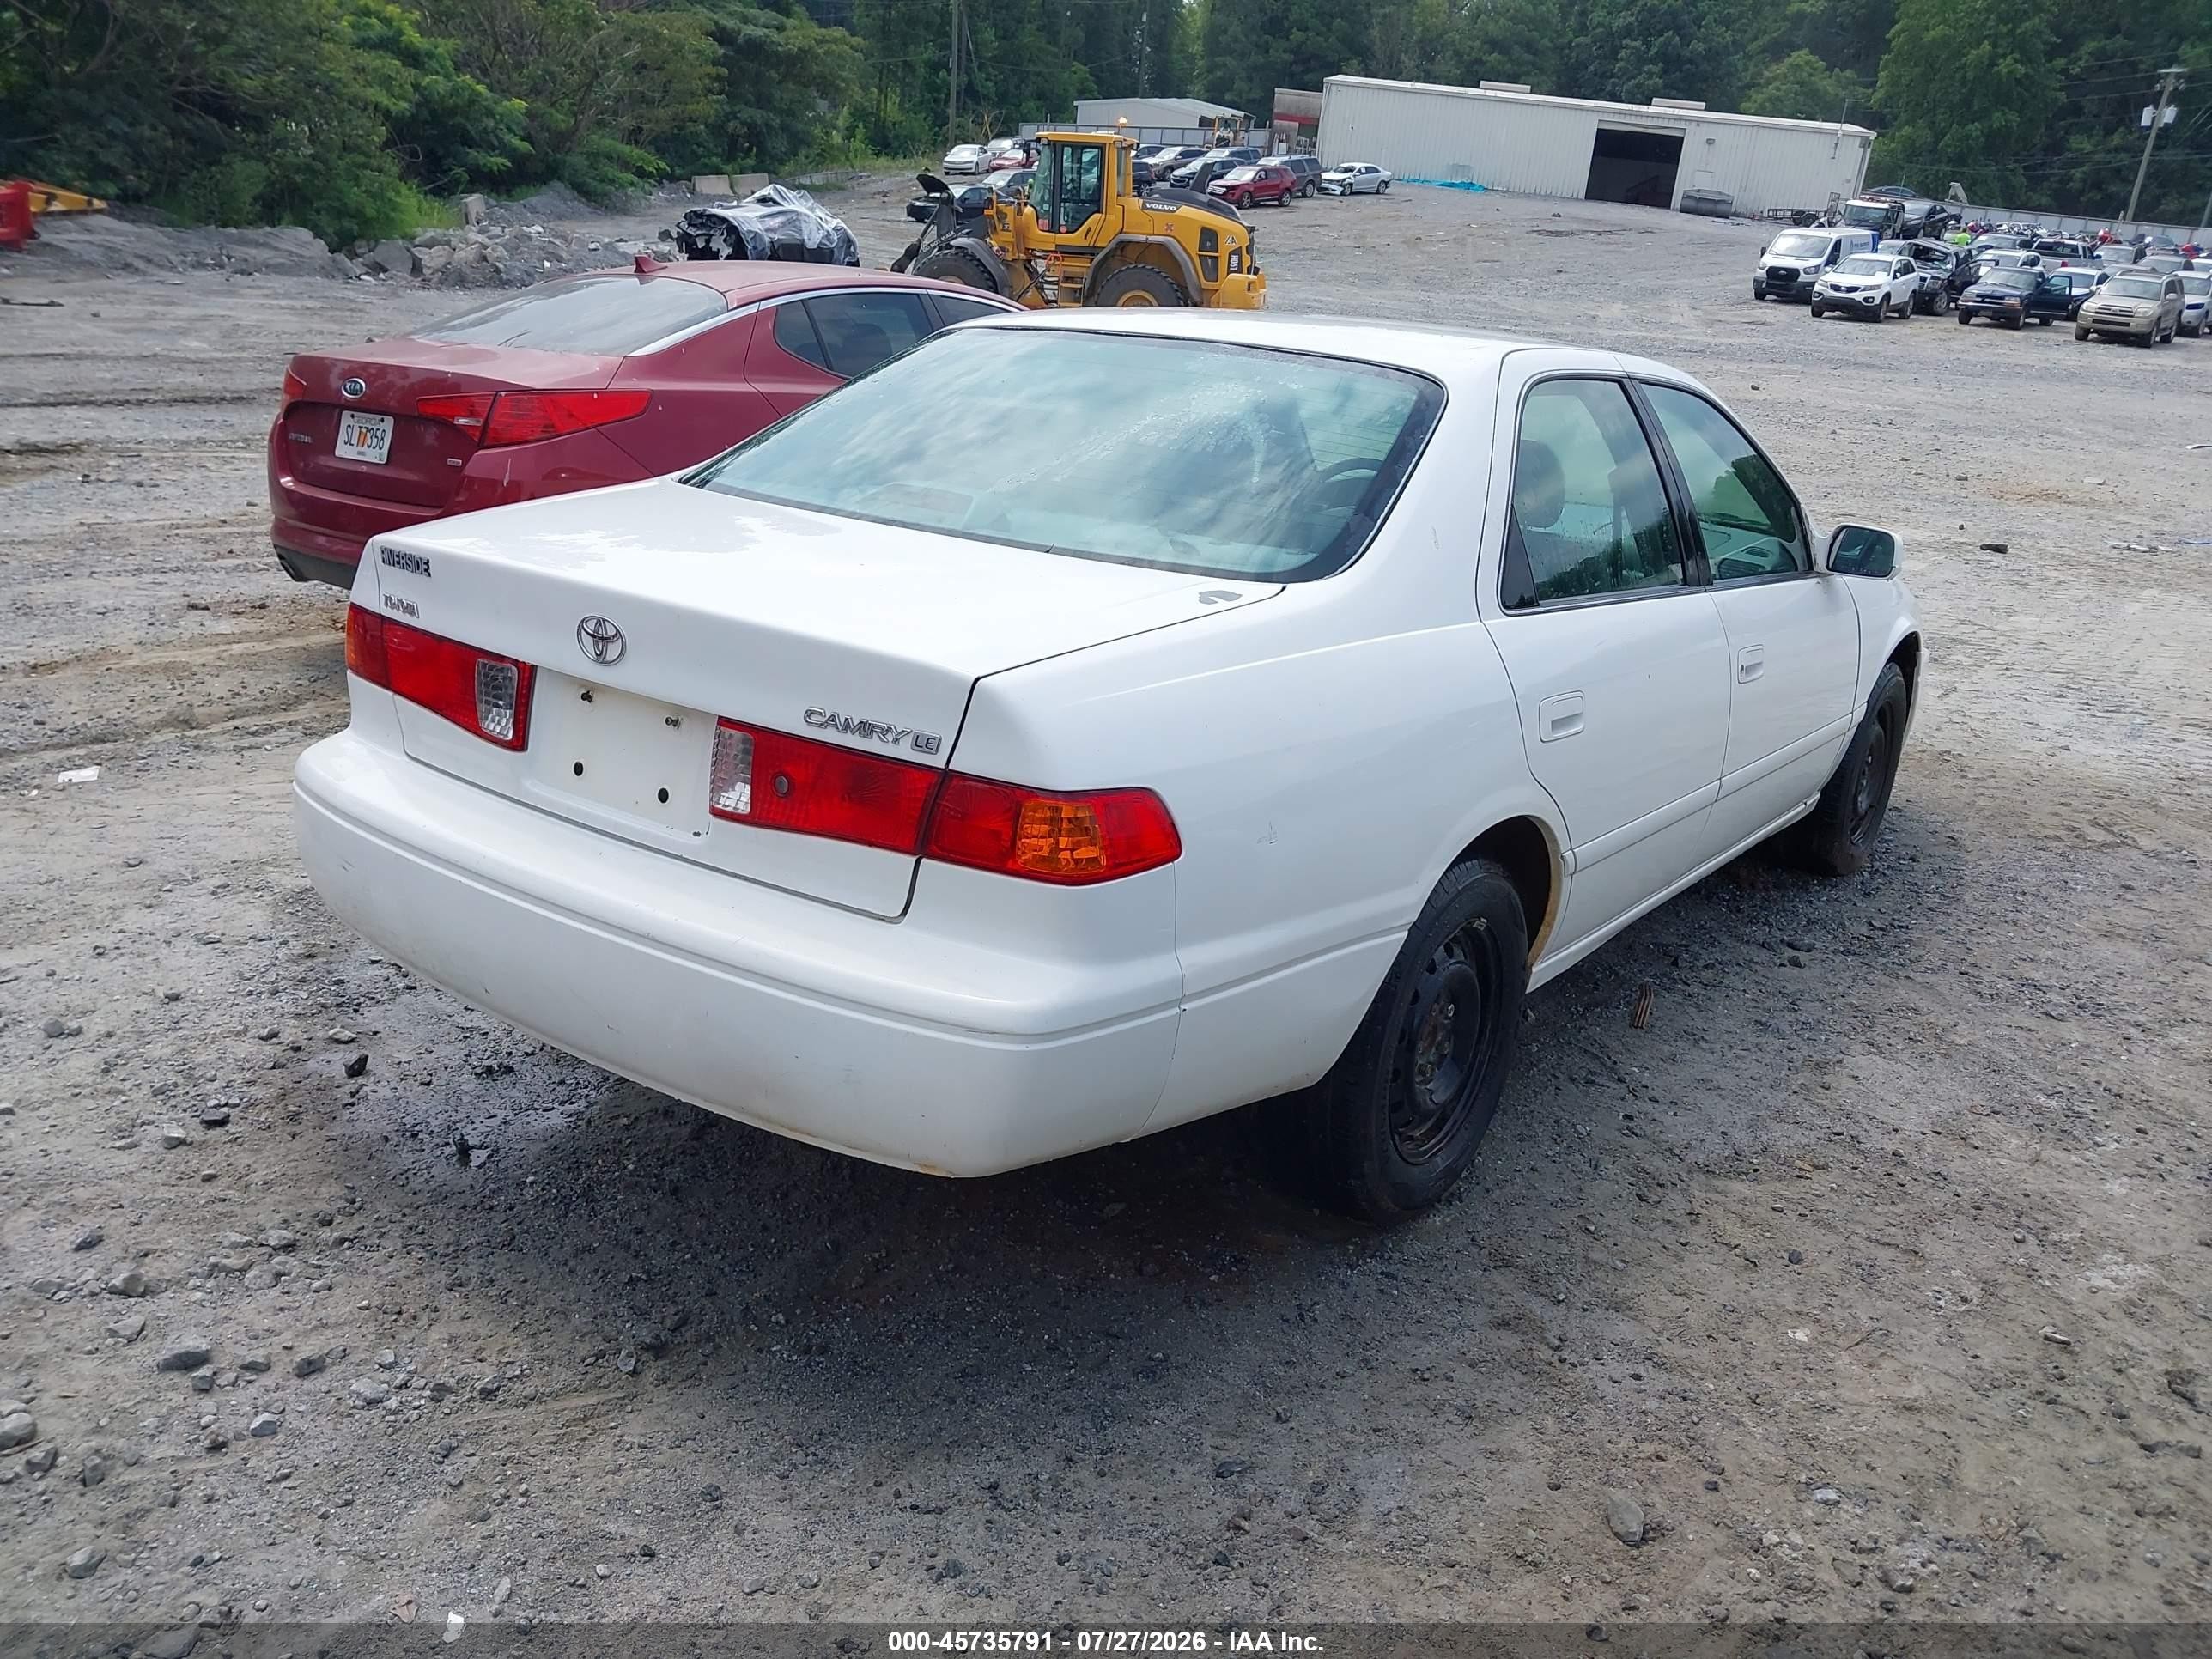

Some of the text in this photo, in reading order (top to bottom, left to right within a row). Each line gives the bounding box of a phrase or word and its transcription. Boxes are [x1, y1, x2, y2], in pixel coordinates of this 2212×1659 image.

[1146, 203, 1177, 211] VOLVO
[1230, 254, 1239, 270] L90H
[380, 545, 431, 577] RIVERSIDE
[804, 707, 913, 745] CAMRY
